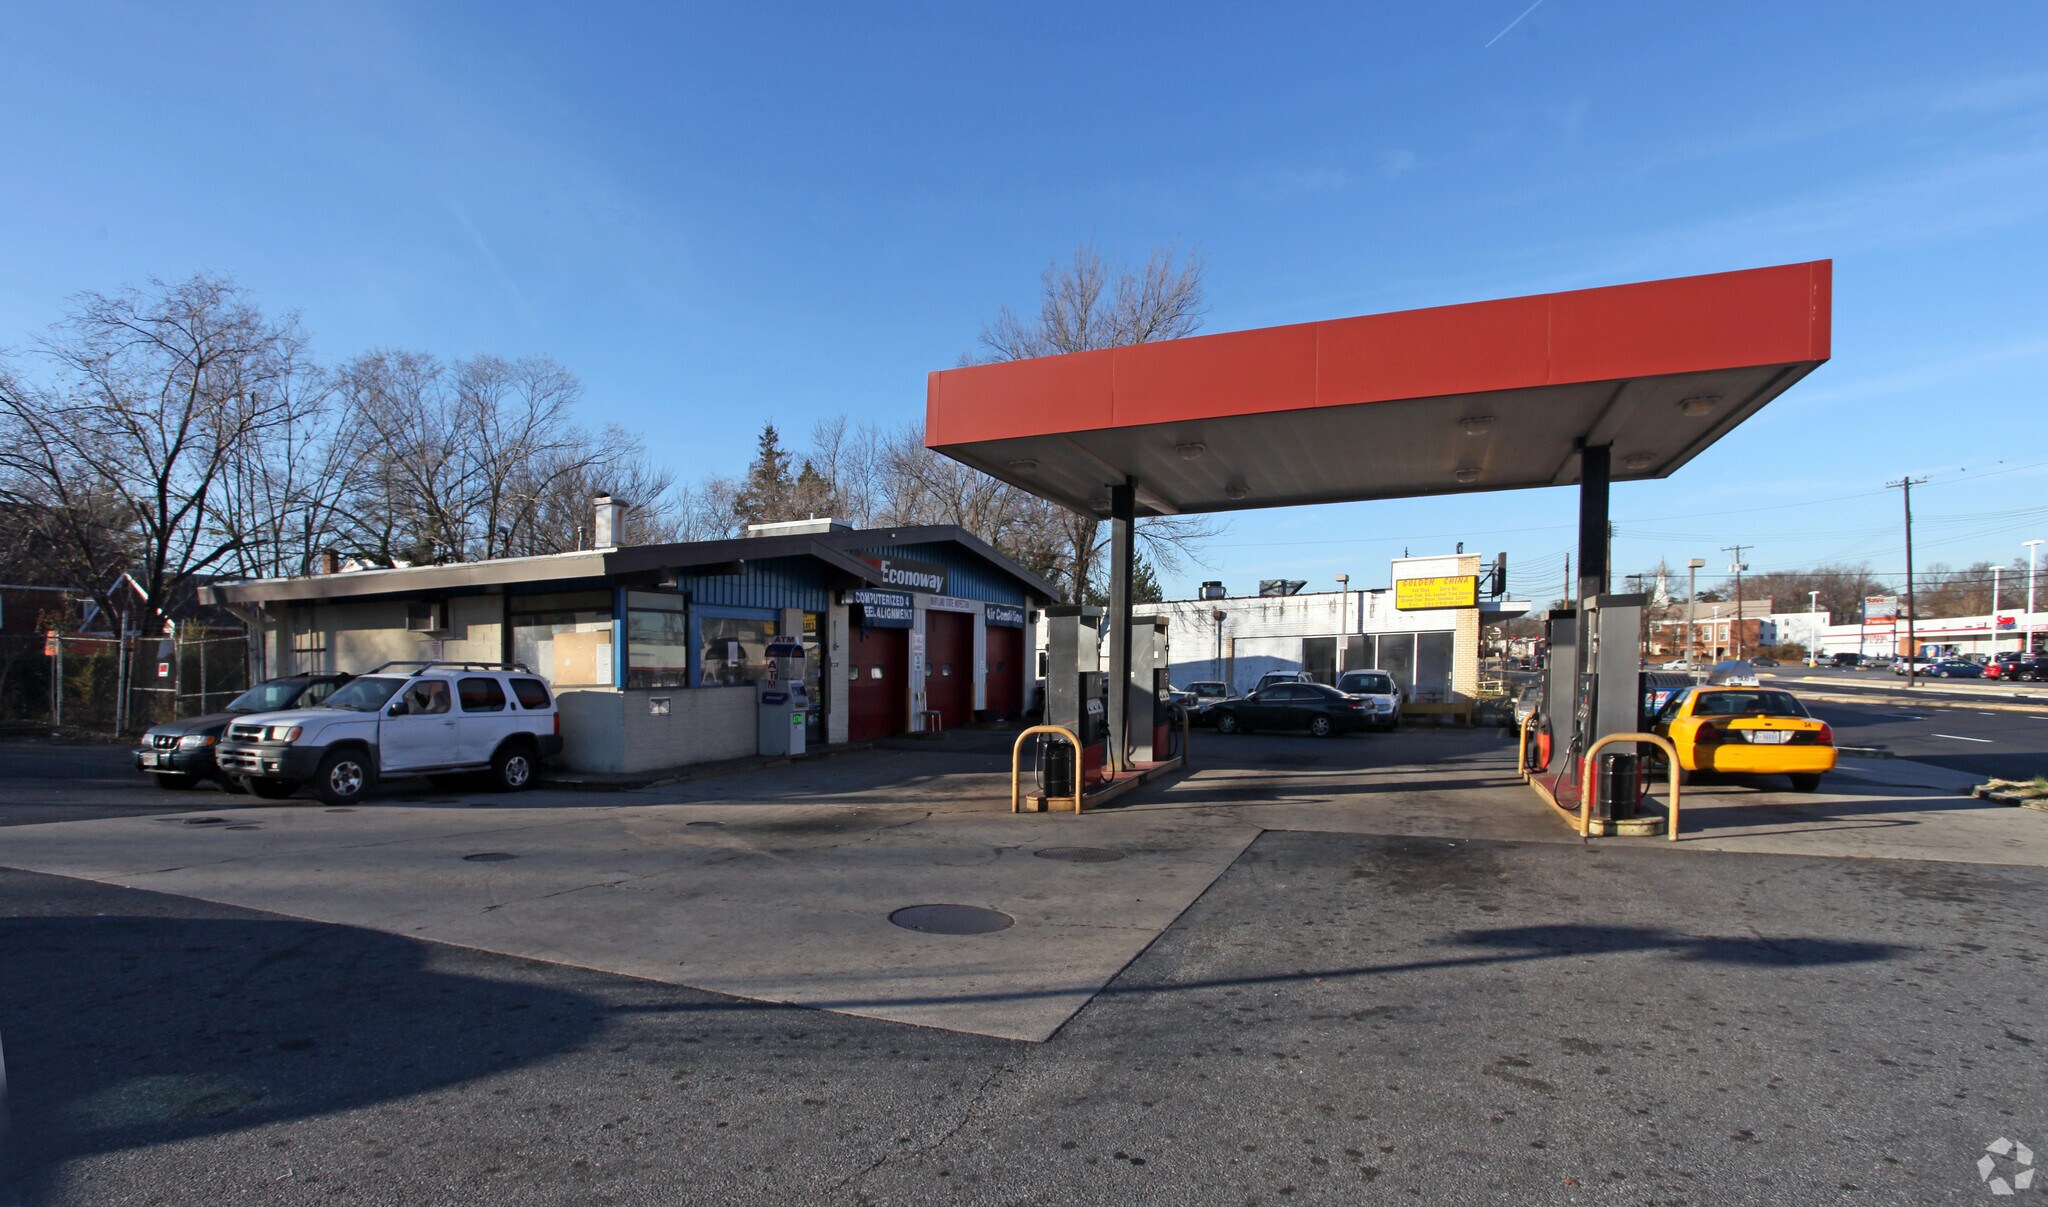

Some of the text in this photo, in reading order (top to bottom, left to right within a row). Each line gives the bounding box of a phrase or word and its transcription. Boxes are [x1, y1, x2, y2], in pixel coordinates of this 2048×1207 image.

[881, 560, 943, 592] Econoway
[1403, 577, 1469, 586] GOLDEN CHINA
[855, 592, 909, 607] COMPUTERIZED 4
[876, 607, 912, 619] ALIGNMENT
[987, 608, 1023, 623] Air Condition
[768, 660, 777, 689] ATM
